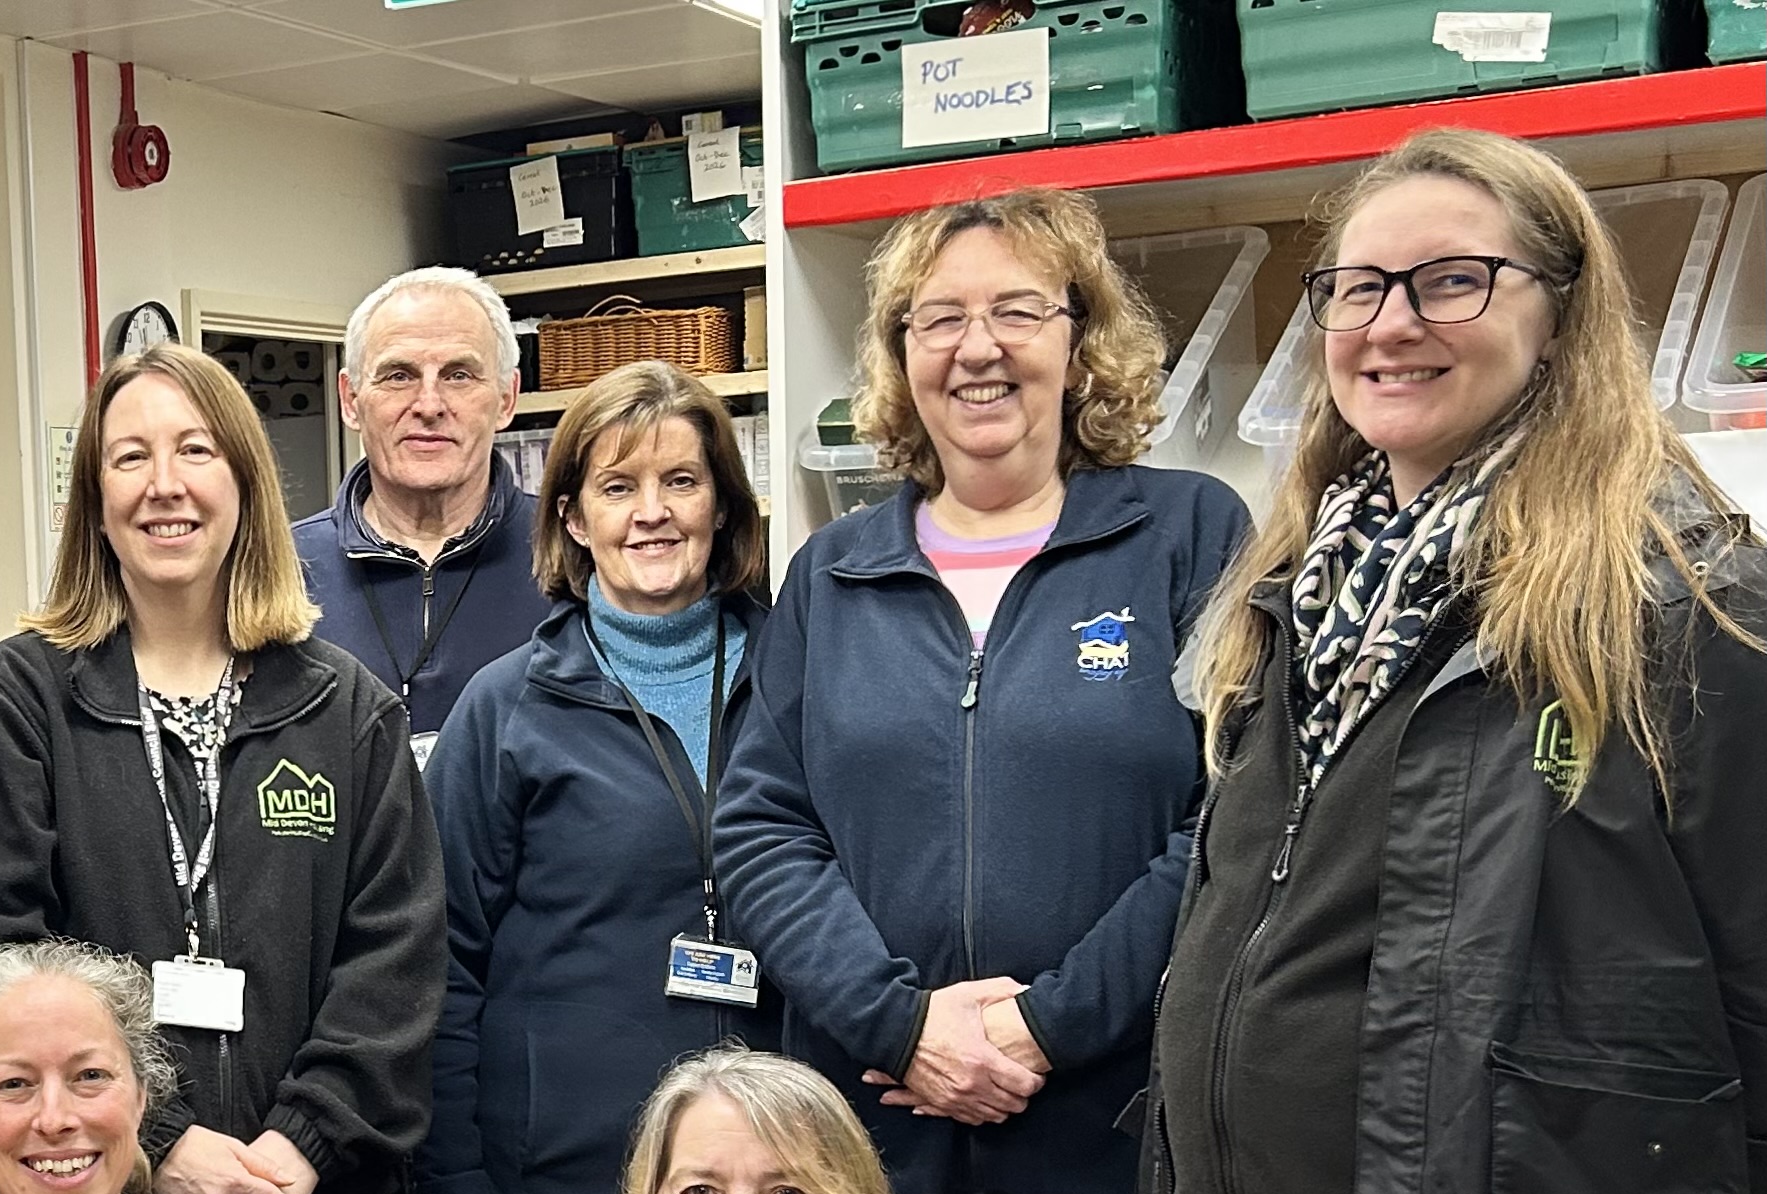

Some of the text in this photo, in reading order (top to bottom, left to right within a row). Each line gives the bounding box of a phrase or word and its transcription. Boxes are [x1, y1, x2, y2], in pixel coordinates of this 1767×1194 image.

[921, 58, 963, 84] POT
[934, 81, 1032, 113] NOODLES
[1077, 652, 1130, 670] CHAT
[145, 733, 163, 778] Council
[266, 789, 327, 815] MDH
[174, 862, 189, 887] Mid
